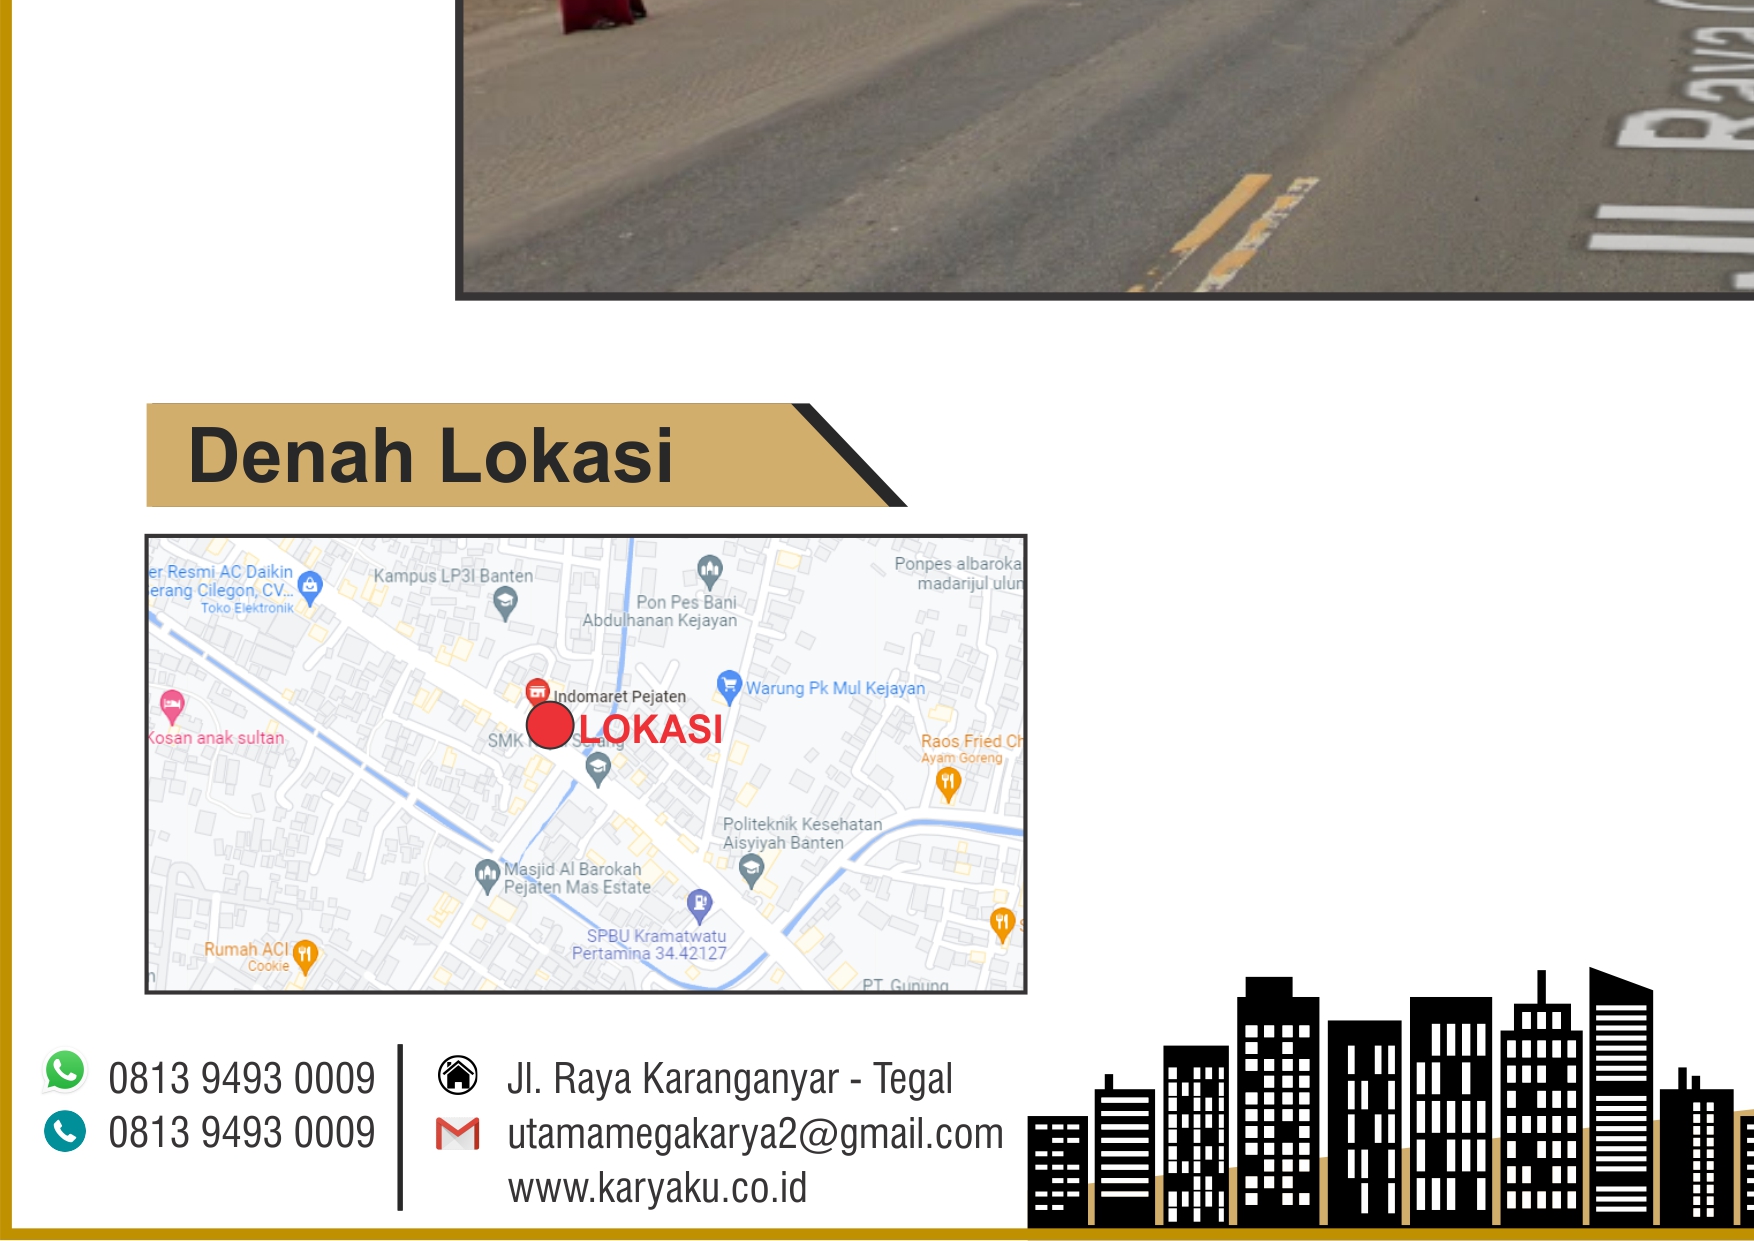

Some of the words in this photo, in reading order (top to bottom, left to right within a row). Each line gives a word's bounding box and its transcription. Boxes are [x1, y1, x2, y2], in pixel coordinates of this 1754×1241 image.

[192, 427, 411, 483] Denah
[443, 427, 670, 483] Lokasi
[168, 565, 215, 578] Resmi
[220, 565, 242, 578] AC
[246, 564, 293, 578] Daikin
[895, 557, 952, 573] Ponpes
[375, 569, 437, 586] Kampus
[481, 569, 533, 582] Banten
[918, 575, 988, 594] madarijul
[148, 586, 193, 600] erang
[198, 583, 258, 600] Cilegon,
[201, 603, 231, 613] Toko
[234, 602, 294, 614] Elektronik
[637, 595, 666, 609] Pon
[672, 595, 698, 609] Pes
[704, 595, 737, 609] Bani
[583, 613, 674, 627] Abdulhanan
[679, 614, 737, 630] Kejayan
[554, 690, 628, 703] Indomaret
[632, 690, 687, 706] Pejaten
[746, 682, 805, 699] Warung
[809, 681, 828, 694] Pk
[833, 681, 861, 695] Mul
[866, 681, 926, 699] Kejayan
[197, 730, 233, 745] anak
[237, 730, 285, 745] sultan
[581, 714, 721, 744] LOKASI
[488, 733, 524, 748] SMK
[921, 734, 960, 748] Raos
[964, 734, 1003, 748] Fried
[921, 753, 956, 765] Ayam
[959, 753, 1003, 765] Goreng
[723, 817, 797, 831] Politeknik
[802, 817, 882, 831] Kesehatan
[723, 835, 786, 852] Aisyiyah
[791, 836, 844, 849] Banten
[504, 862, 555, 880] Masjid
[559, 862, 574, 875] Al
[580, 862, 642, 876] Barokah
[504, 880, 561, 897] Pejaten
[566, 880, 599, 894] Mas
[603, 880, 651, 894] Estate
[587, 929, 630, 943] SPBU
[635, 929, 727, 943] Kramatwatu
[205, 942, 258, 957] Rumah
[263, 942, 289, 957] ACI
[572, 946, 651, 960] Pertamina
[655, 946, 727, 960] 34.42127
[248, 960, 289, 972] Cookie
[110, 1062, 188, 1094] 0813
[202, 1062, 281, 1094] 9493
[295, 1062, 374, 1094] 0009
[508, 1062, 540, 1094] Jl.
[556, 1062, 631, 1101] Raya
[645, 1062, 839, 1101] Karanganyar
[873, 1062, 951, 1101] Tegal
[110, 1116, 188, 1148] 0813
[202, 1116, 281, 1148] 9493
[295, 1116, 374, 1148] 0009
[510, 1117, 1002, 1156] utamamegakarya2@gmail.com
[508, 1171, 805, 1210] www.karyaku.co.id
